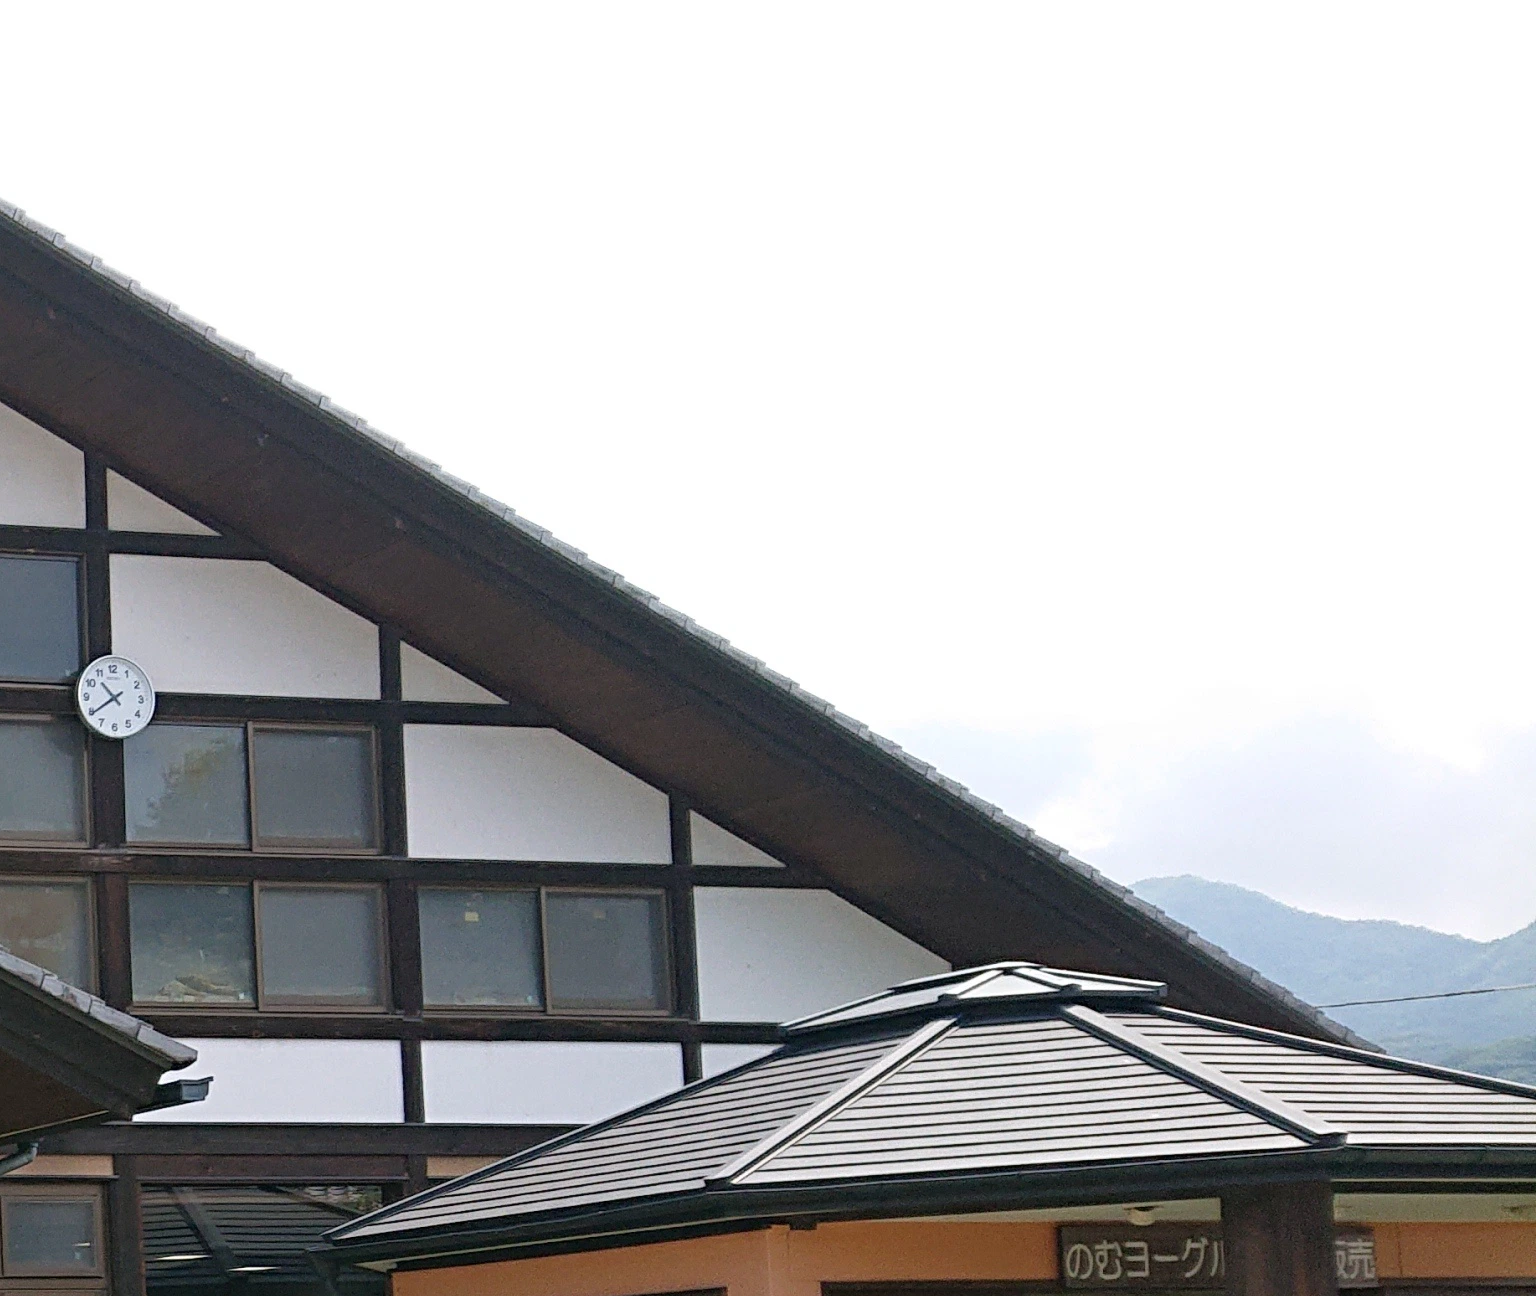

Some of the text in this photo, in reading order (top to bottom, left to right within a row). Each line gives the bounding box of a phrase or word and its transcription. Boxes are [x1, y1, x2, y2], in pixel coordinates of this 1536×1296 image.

[96, 668, 104, 677] 11
[108, 665, 118, 674] 12
[124, 669, 129, 678] 1
[85, 678, 96, 688] 10
[133, 680, 141, 689] 2
[83, 692, 90, 701] 9
[137, 695, 145, 704] 3
[134, 709, 141, 718] 4
[98, 718, 105, 727] 7
[111, 722, 119, 732] 6
[125, 719, 132, 728] 5
